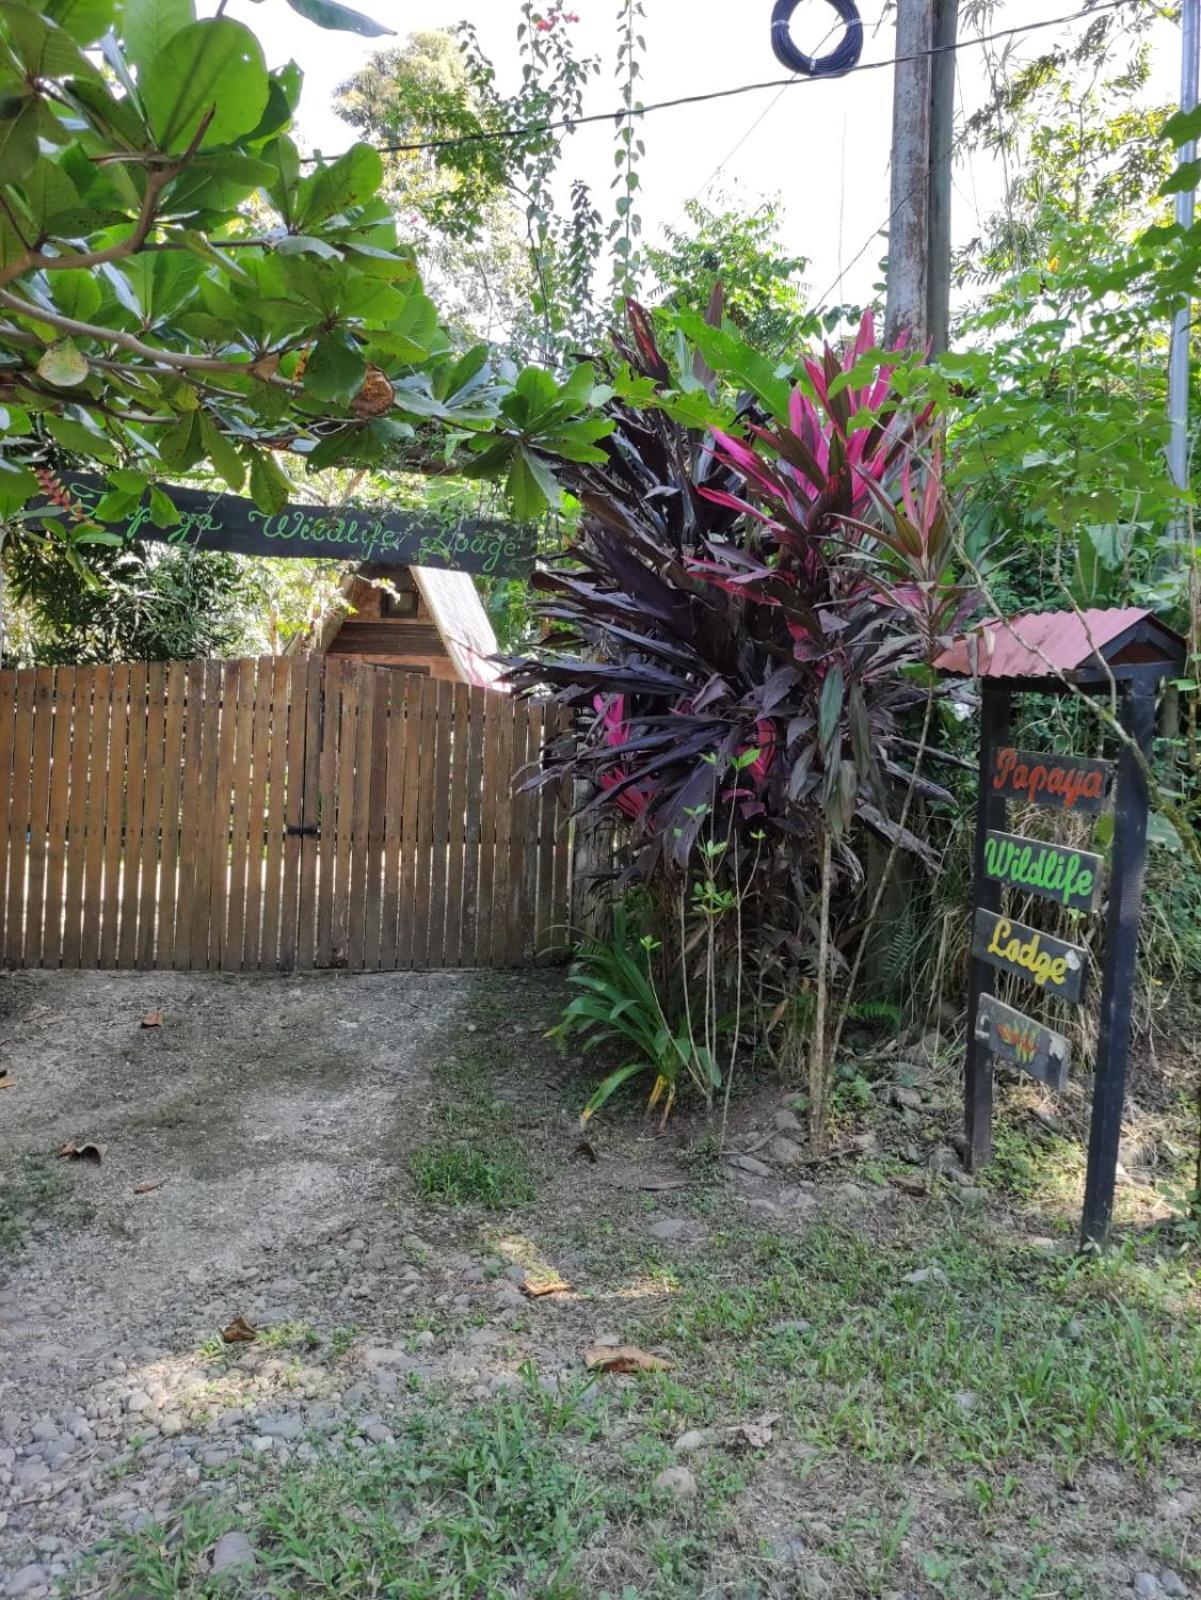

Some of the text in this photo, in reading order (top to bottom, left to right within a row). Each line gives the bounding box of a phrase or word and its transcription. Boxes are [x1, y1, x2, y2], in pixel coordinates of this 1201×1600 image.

[994, 747, 1104, 808] Papaya
[985, 838, 1093, 904] Wildlife
[988, 920, 1068, 985] Lodge
